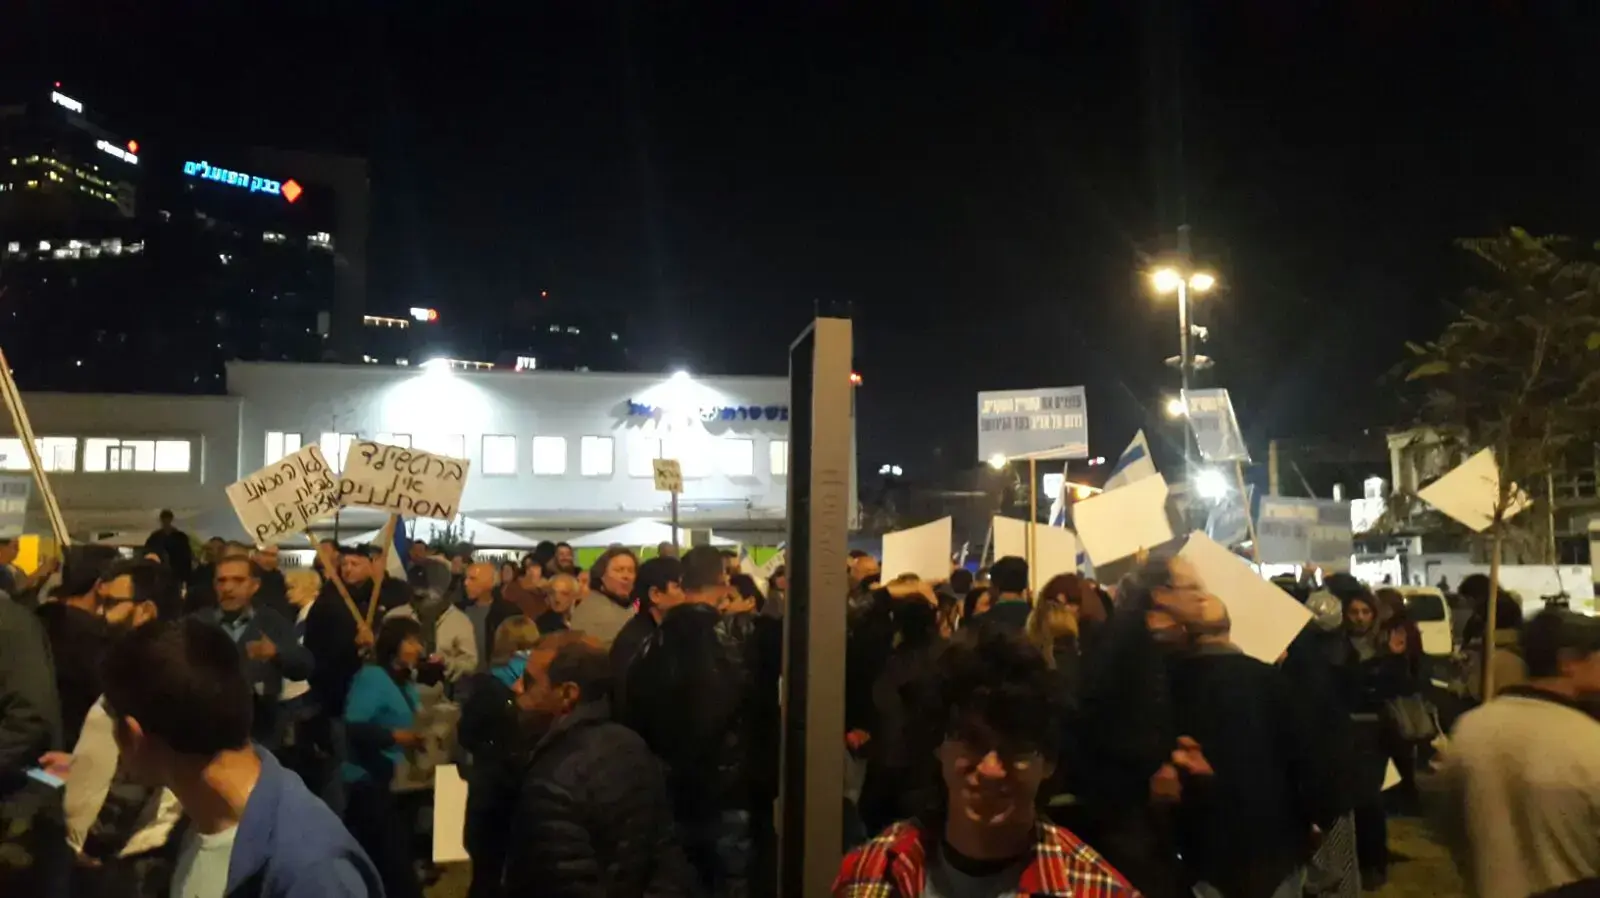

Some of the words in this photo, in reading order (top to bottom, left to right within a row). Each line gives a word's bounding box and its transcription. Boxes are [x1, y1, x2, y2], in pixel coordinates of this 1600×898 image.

[184, 160, 250, 188] הפועלים
[250, 176, 281, 195] בנק
[298, 445, 322, 475] לא
[244, 463, 297, 503] הסכמנו
[391, 474, 424, 494] אין
[338, 478, 452, 518] מסתננים
